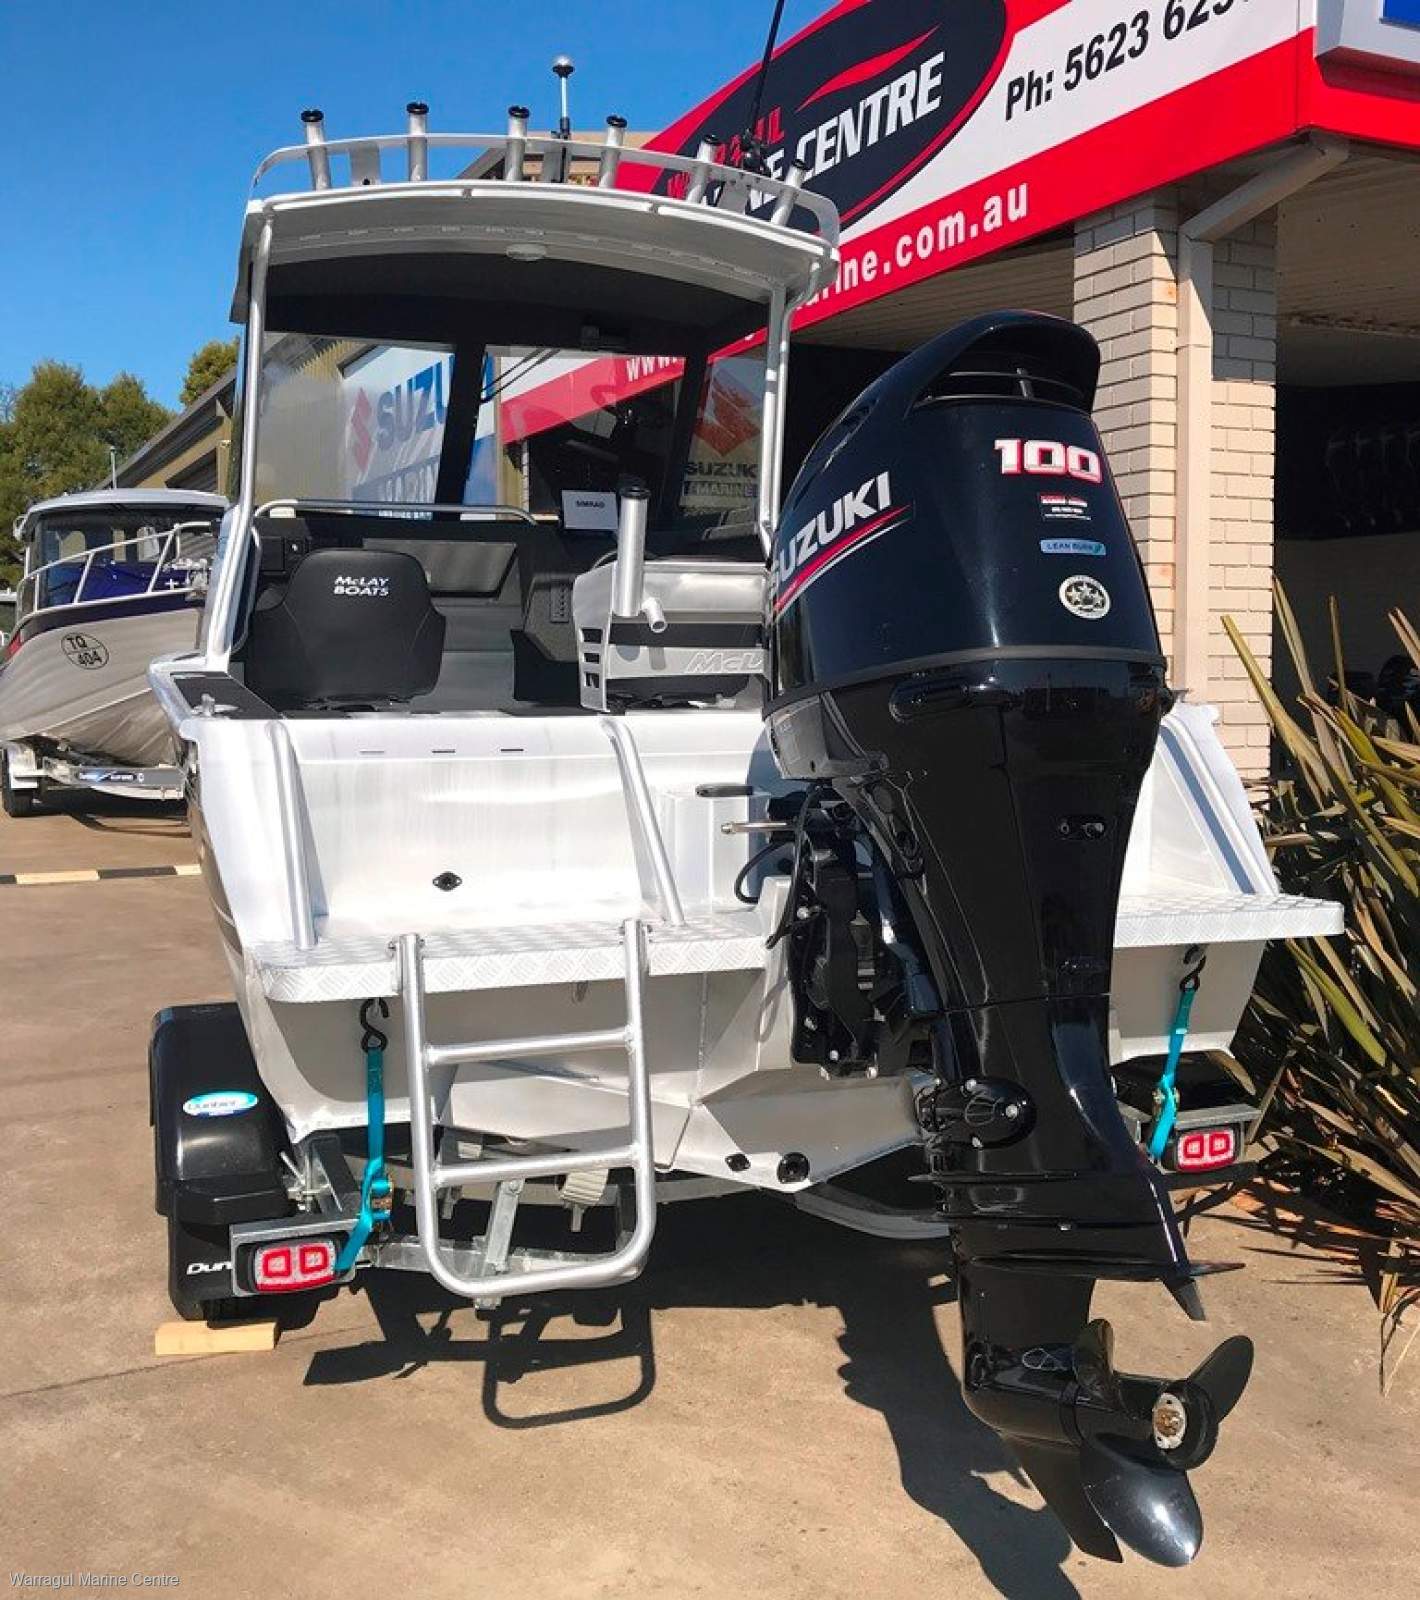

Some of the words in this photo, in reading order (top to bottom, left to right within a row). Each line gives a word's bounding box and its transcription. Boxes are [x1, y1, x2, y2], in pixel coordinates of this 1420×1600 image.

[1005, 71, 1054, 121] Ph:
[1063, 10, 1150, 92] 5623
[796, 51, 945, 184] CENTRE
[994, 438, 1103, 484] 100
[334, 585, 389, 597] BOATS
[66, 635, 88, 650] TQ
[186, 1261, 232, 1275] Dun
